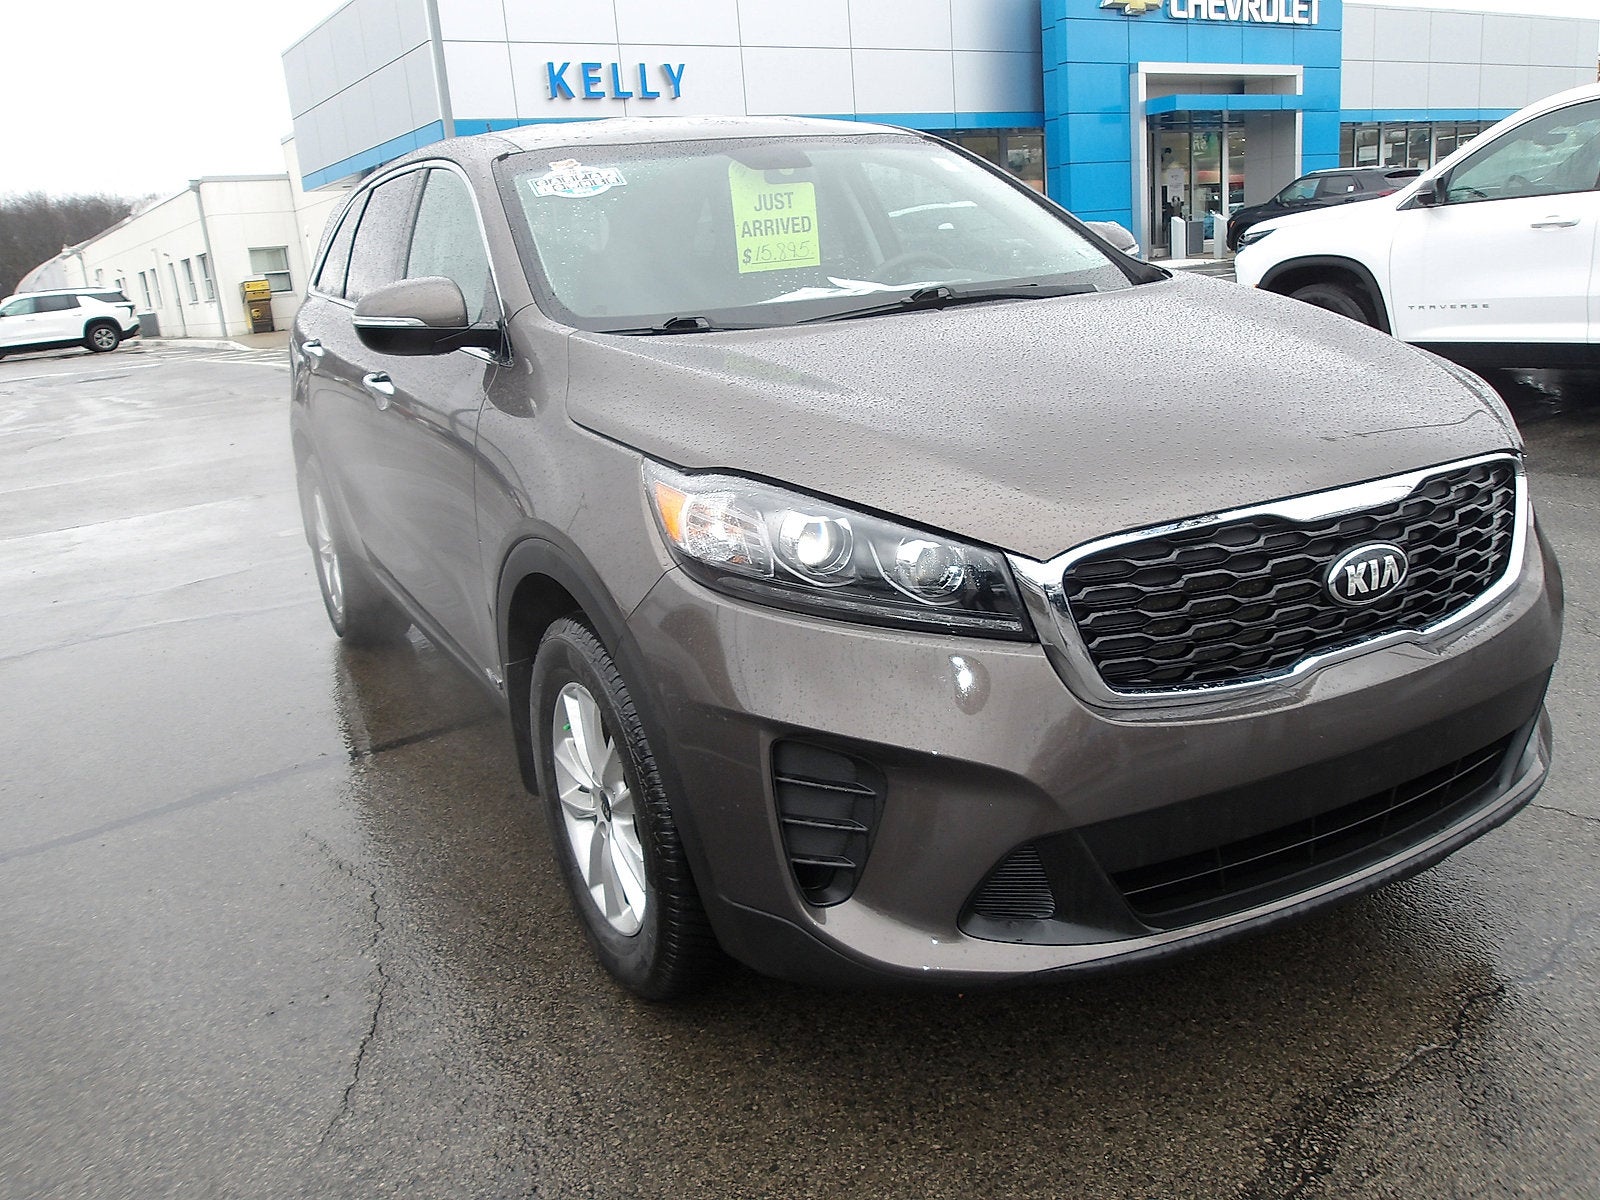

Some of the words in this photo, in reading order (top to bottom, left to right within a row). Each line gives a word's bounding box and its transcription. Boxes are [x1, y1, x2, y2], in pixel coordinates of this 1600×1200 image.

[547, 61, 685, 100] KELLY
[754, 191, 794, 212] JUST
[741, 215, 812, 238] ARRIVED
[1344, 555, 1399, 596] KIA
